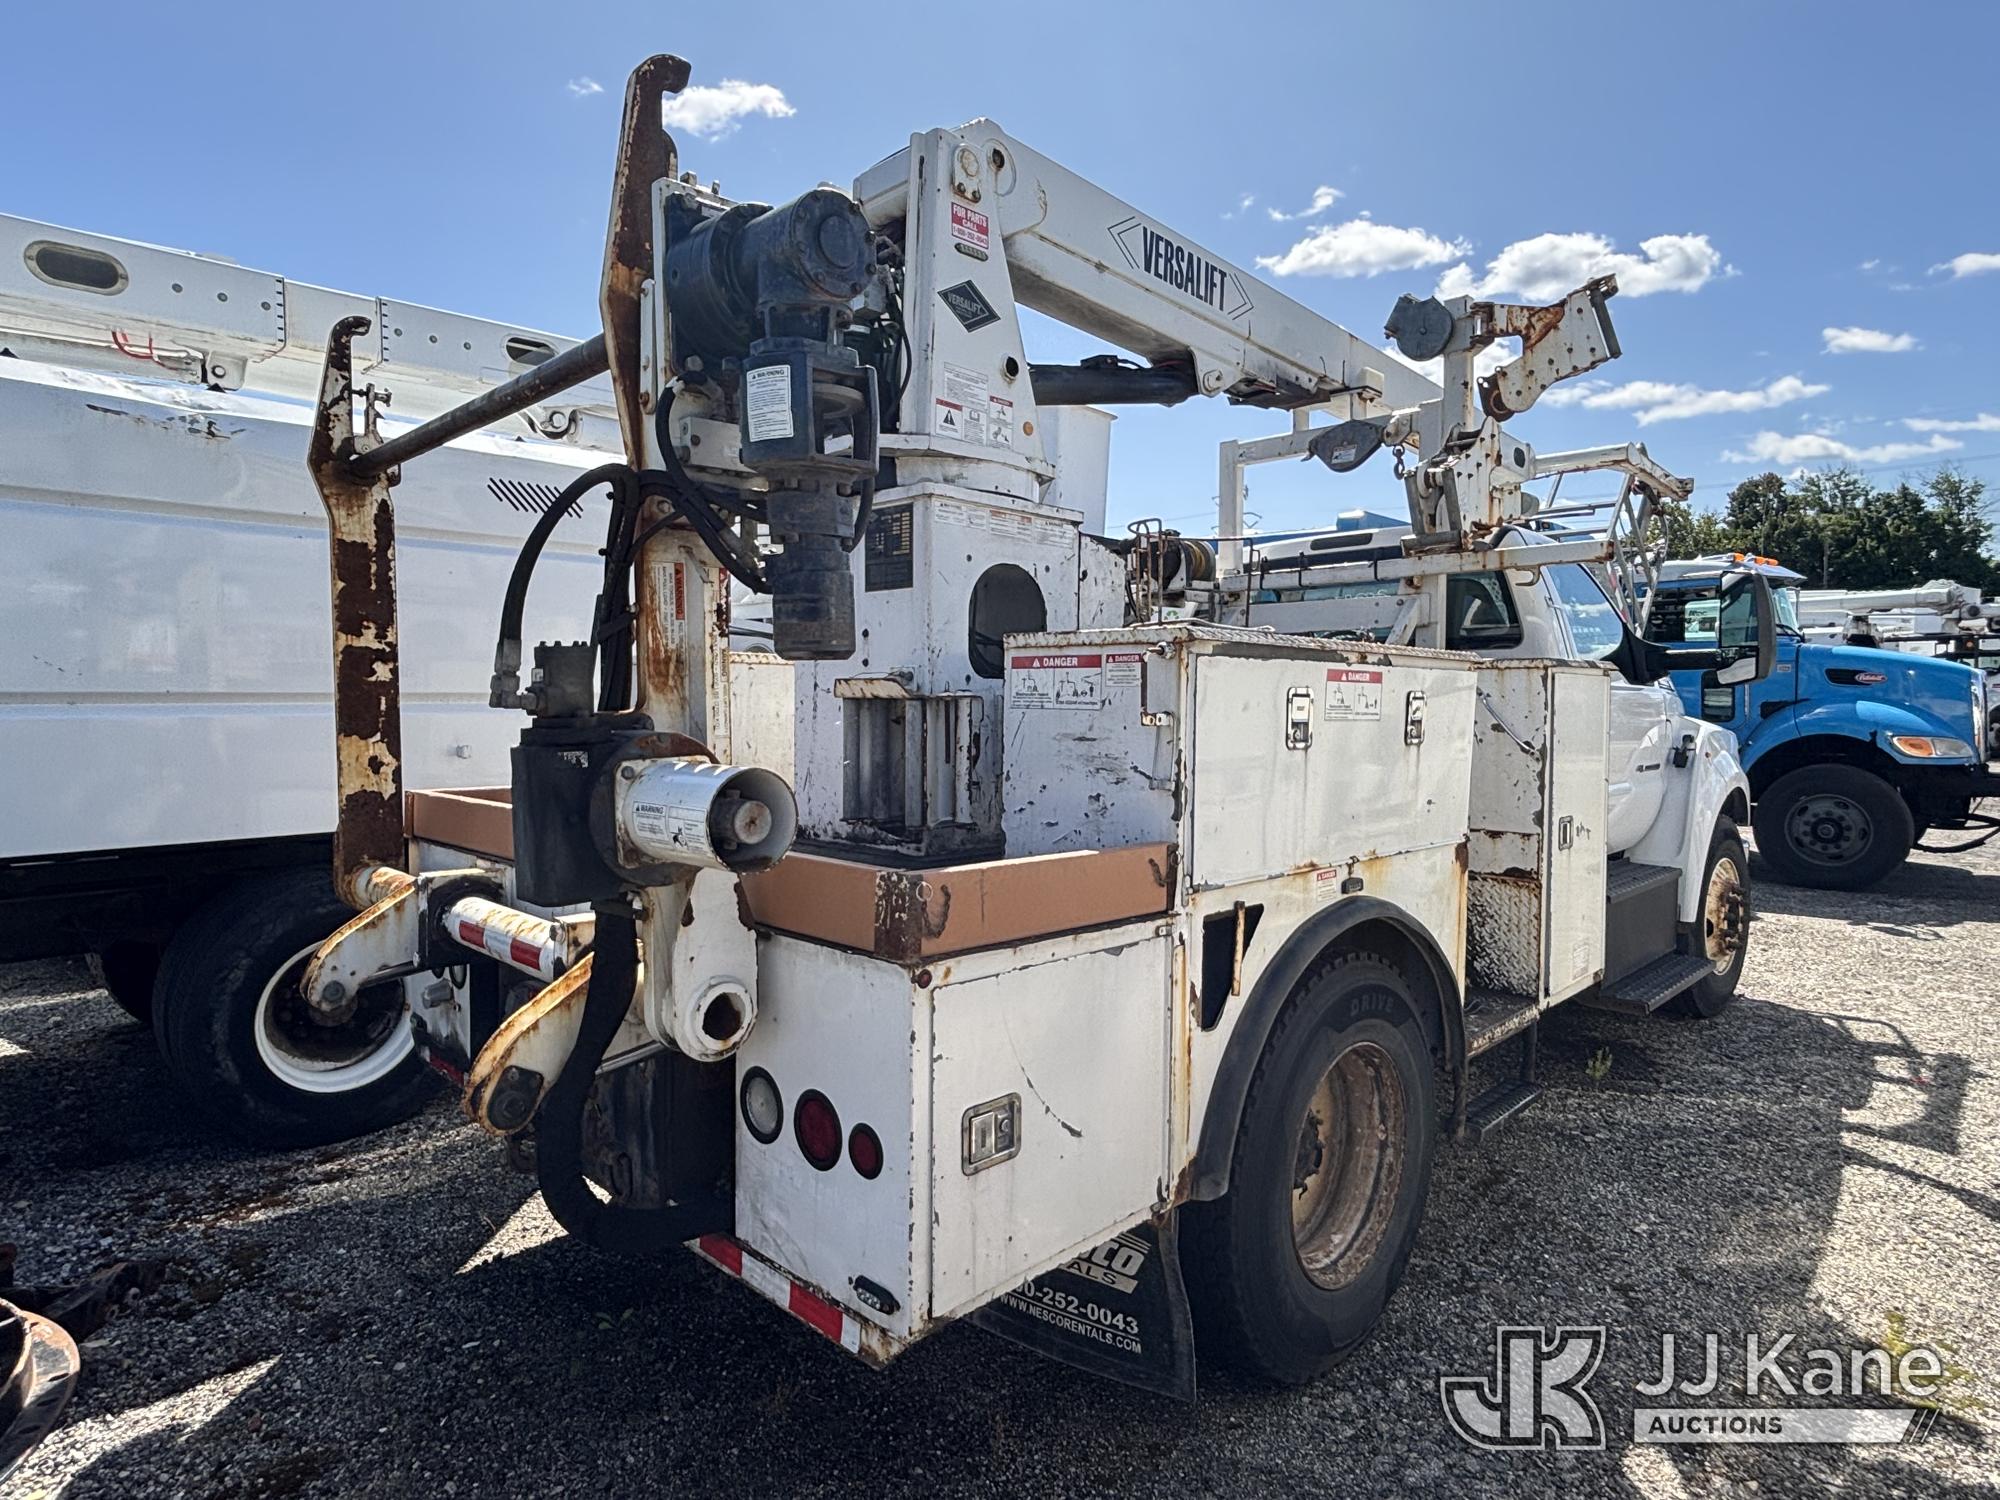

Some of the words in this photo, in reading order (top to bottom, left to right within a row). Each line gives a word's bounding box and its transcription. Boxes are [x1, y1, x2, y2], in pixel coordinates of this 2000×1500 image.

[953, 204, 967, 219] FOR
[967, 209, 988, 228] PARTS
[962, 219, 979, 232] CALL
[1143, 226, 1227, 312] VERSALIFT
[947, 291, 982, 315] VERSALIFT
[1043, 657, 1078, 667] DANGER
[1348, 672, 1370, 681] DANGER
[641, 804, 664, 814] WARNING
[1350, 992, 1393, 1016] DRIVE
